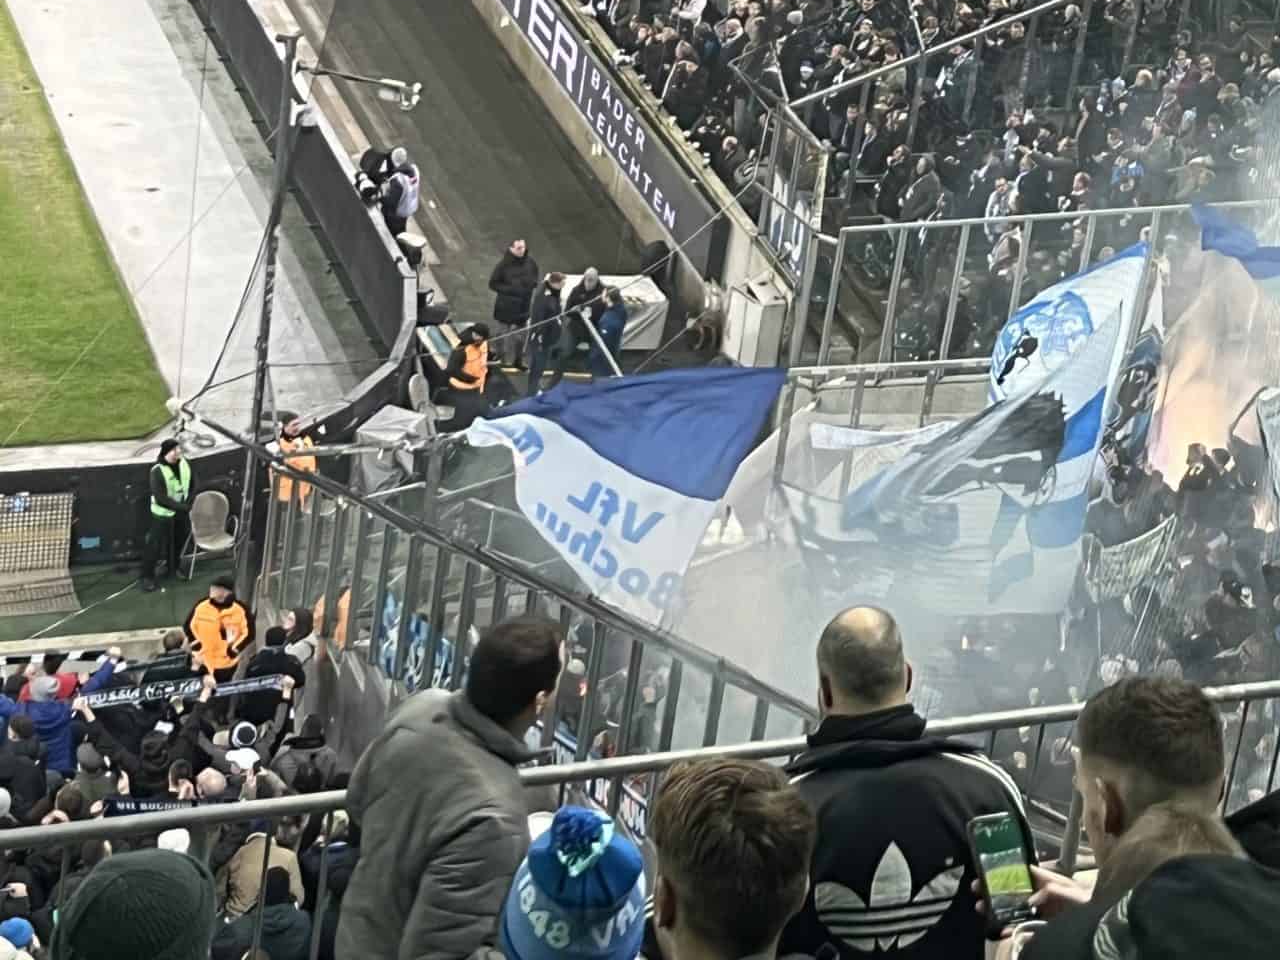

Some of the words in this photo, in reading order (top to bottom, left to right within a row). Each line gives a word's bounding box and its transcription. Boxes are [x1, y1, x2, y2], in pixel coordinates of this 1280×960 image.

[590, 67, 645, 150] BÄDER
[586, 98, 676, 229] LEUCHTEN
[517, 872, 571, 950] 1848
